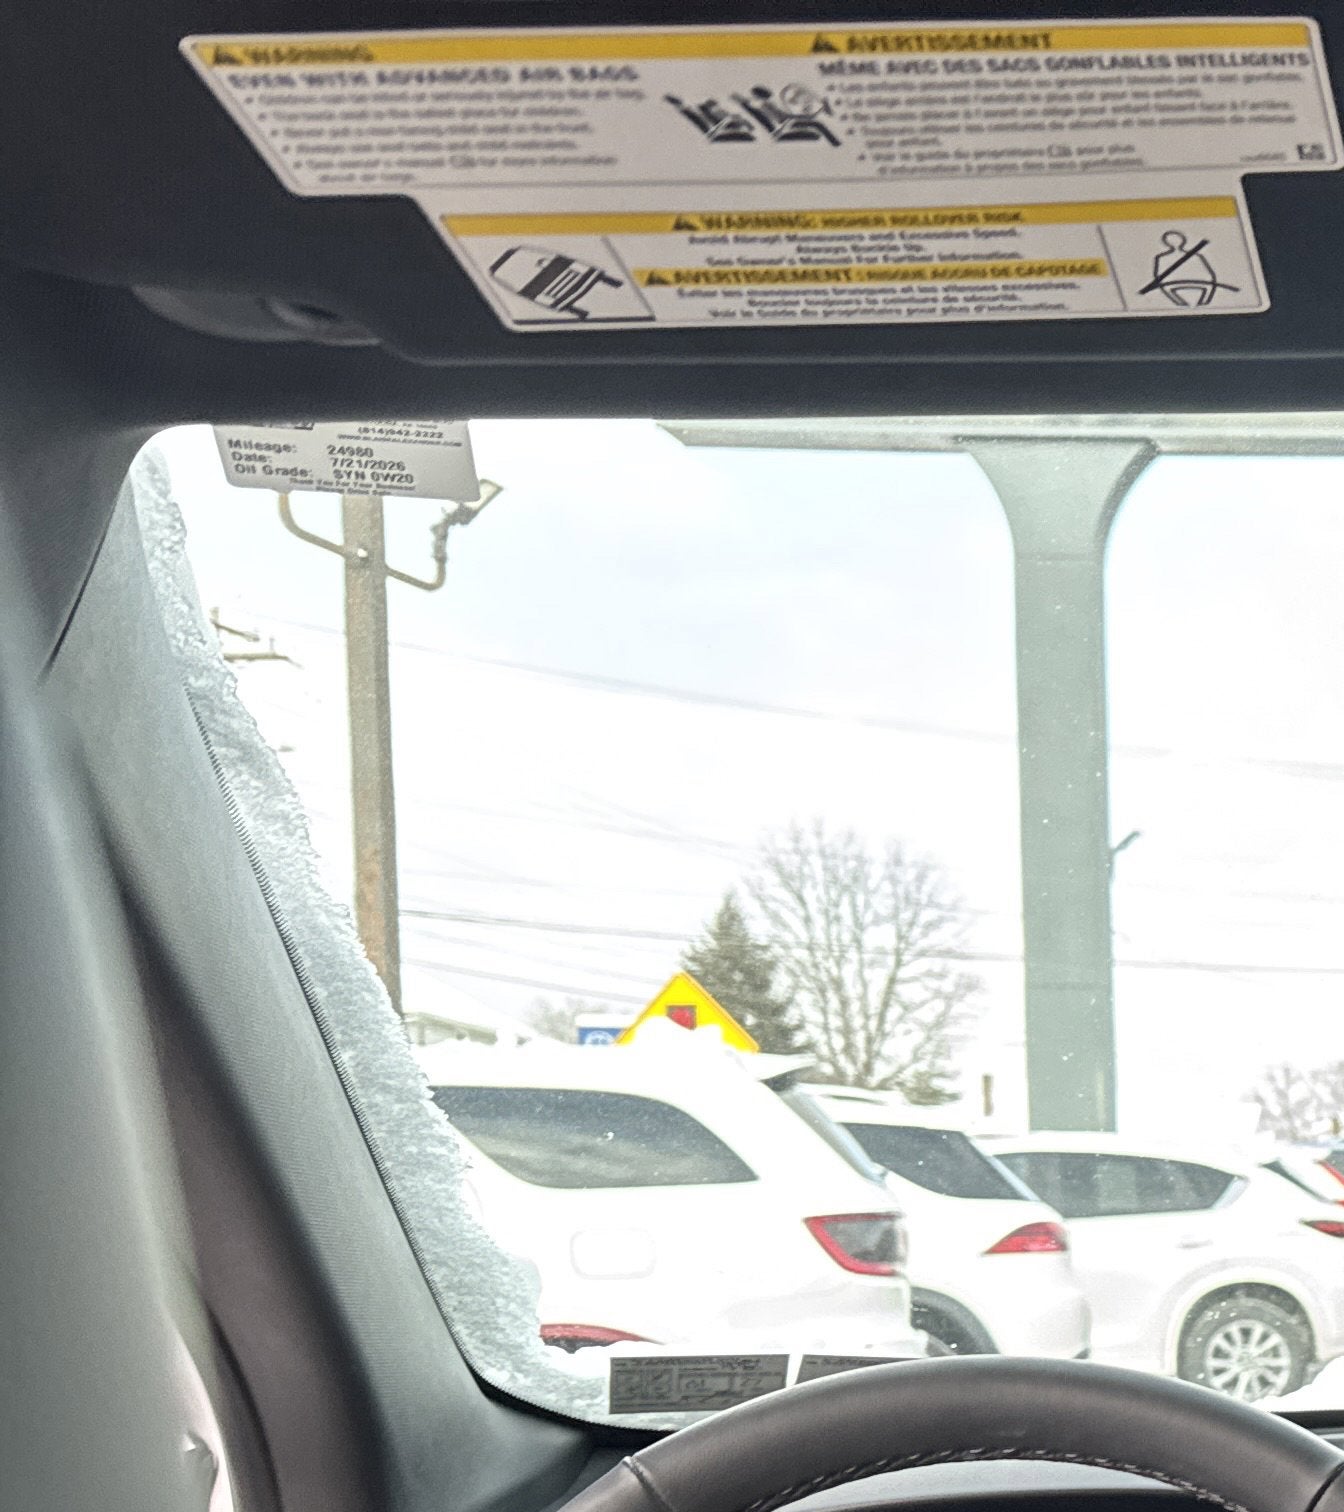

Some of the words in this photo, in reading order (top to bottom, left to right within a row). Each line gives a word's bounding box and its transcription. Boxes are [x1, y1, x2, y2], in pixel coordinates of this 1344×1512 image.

[848, 33, 1051, 52] AVERTISSEMENT
[886, 58, 939, 75] AVEC
[942, 57, 984, 74] DES
[987, 56, 1042, 73] SACS
[1045, 53, 1172, 71] GONFLABLES
[1175, 51, 1310, 68] INTELLIGENTS
[227, 438, 297, 454] Mileage:
[231, 451, 272, 464] Date:
[330, 457, 407, 472] 7/21/2026
[234, 463, 257, 474] Oil
[262, 464, 314, 478] Grade:
[332, 468, 366, 481] SYN
[370, 471, 414, 484] 0W20
